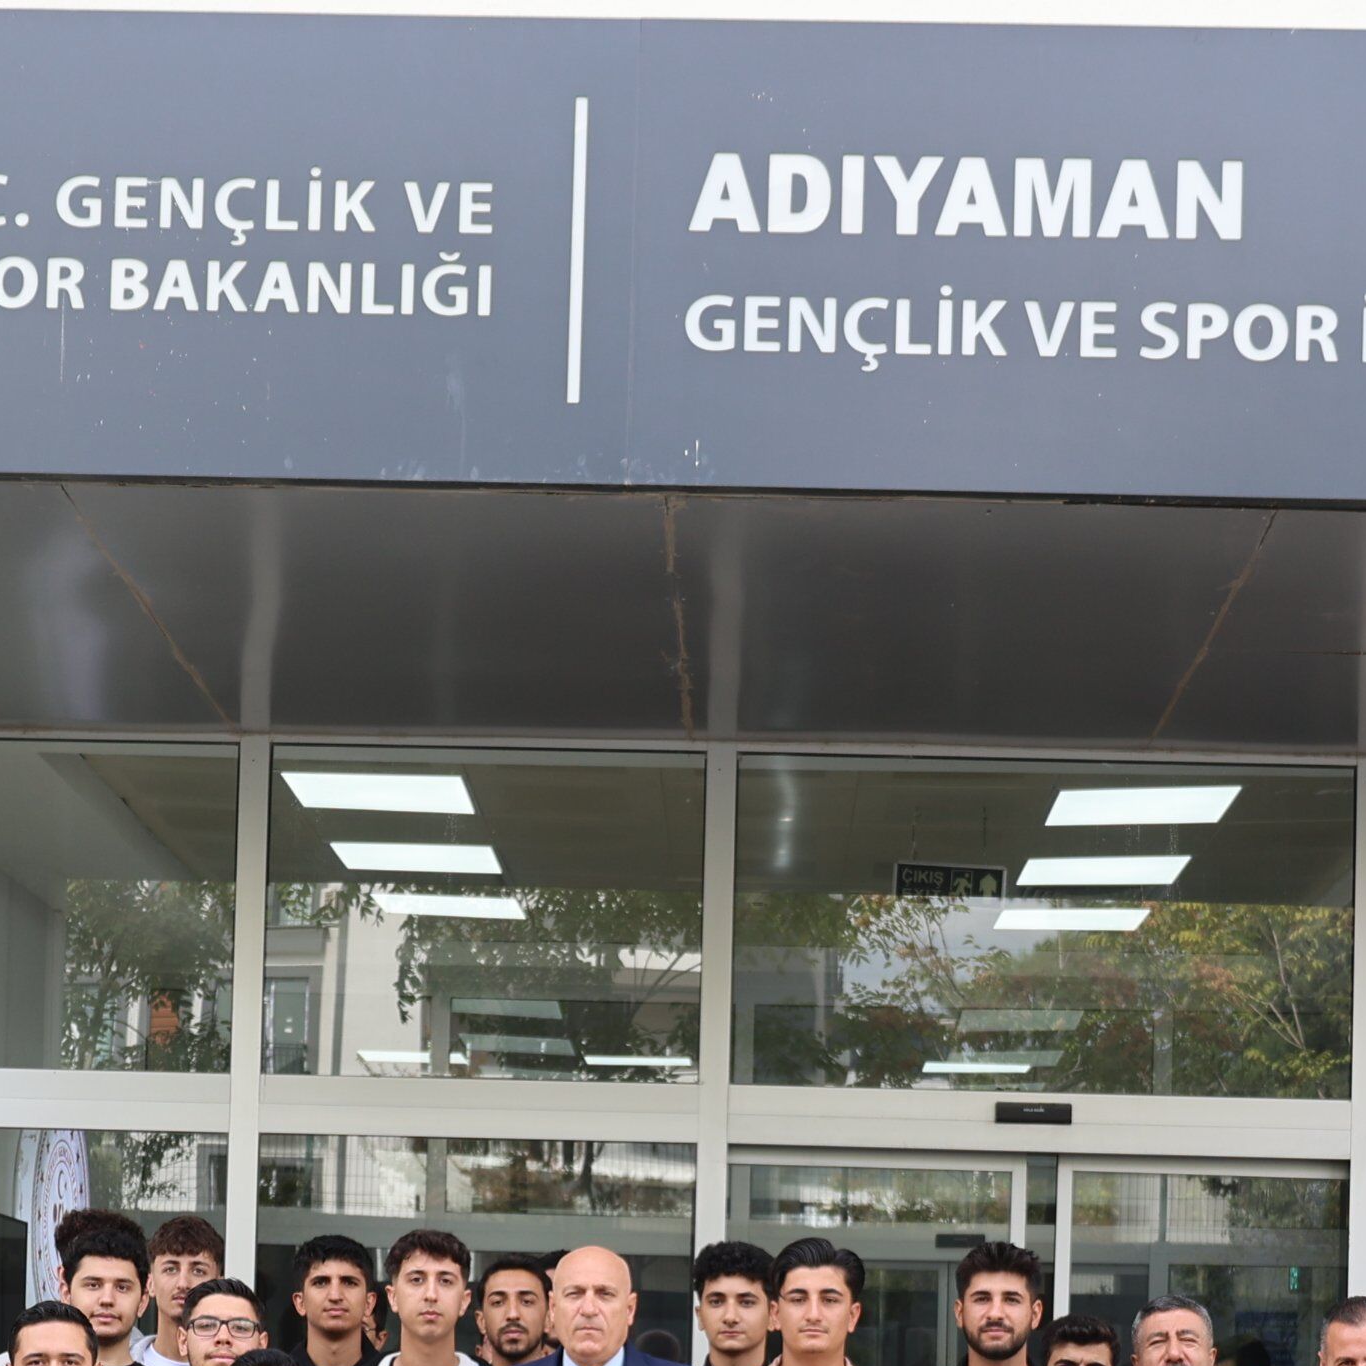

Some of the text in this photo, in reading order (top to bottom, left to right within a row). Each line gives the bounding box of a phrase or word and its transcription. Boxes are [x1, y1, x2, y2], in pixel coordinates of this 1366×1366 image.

[56, 167, 376, 247] GENÇLİK
[404, 181, 494, 235] VE
[688, 153, 1243, 240] ADIYAMAN
[110, 250, 493, 317] BAKANLIĞI
[685, 284, 1008, 373] GENÇLİK
[1024, 300, 1117, 359] VE
[1139, 302, 1338, 363] SPOR
[901, 867, 945, 889] ÇIKIŞ
